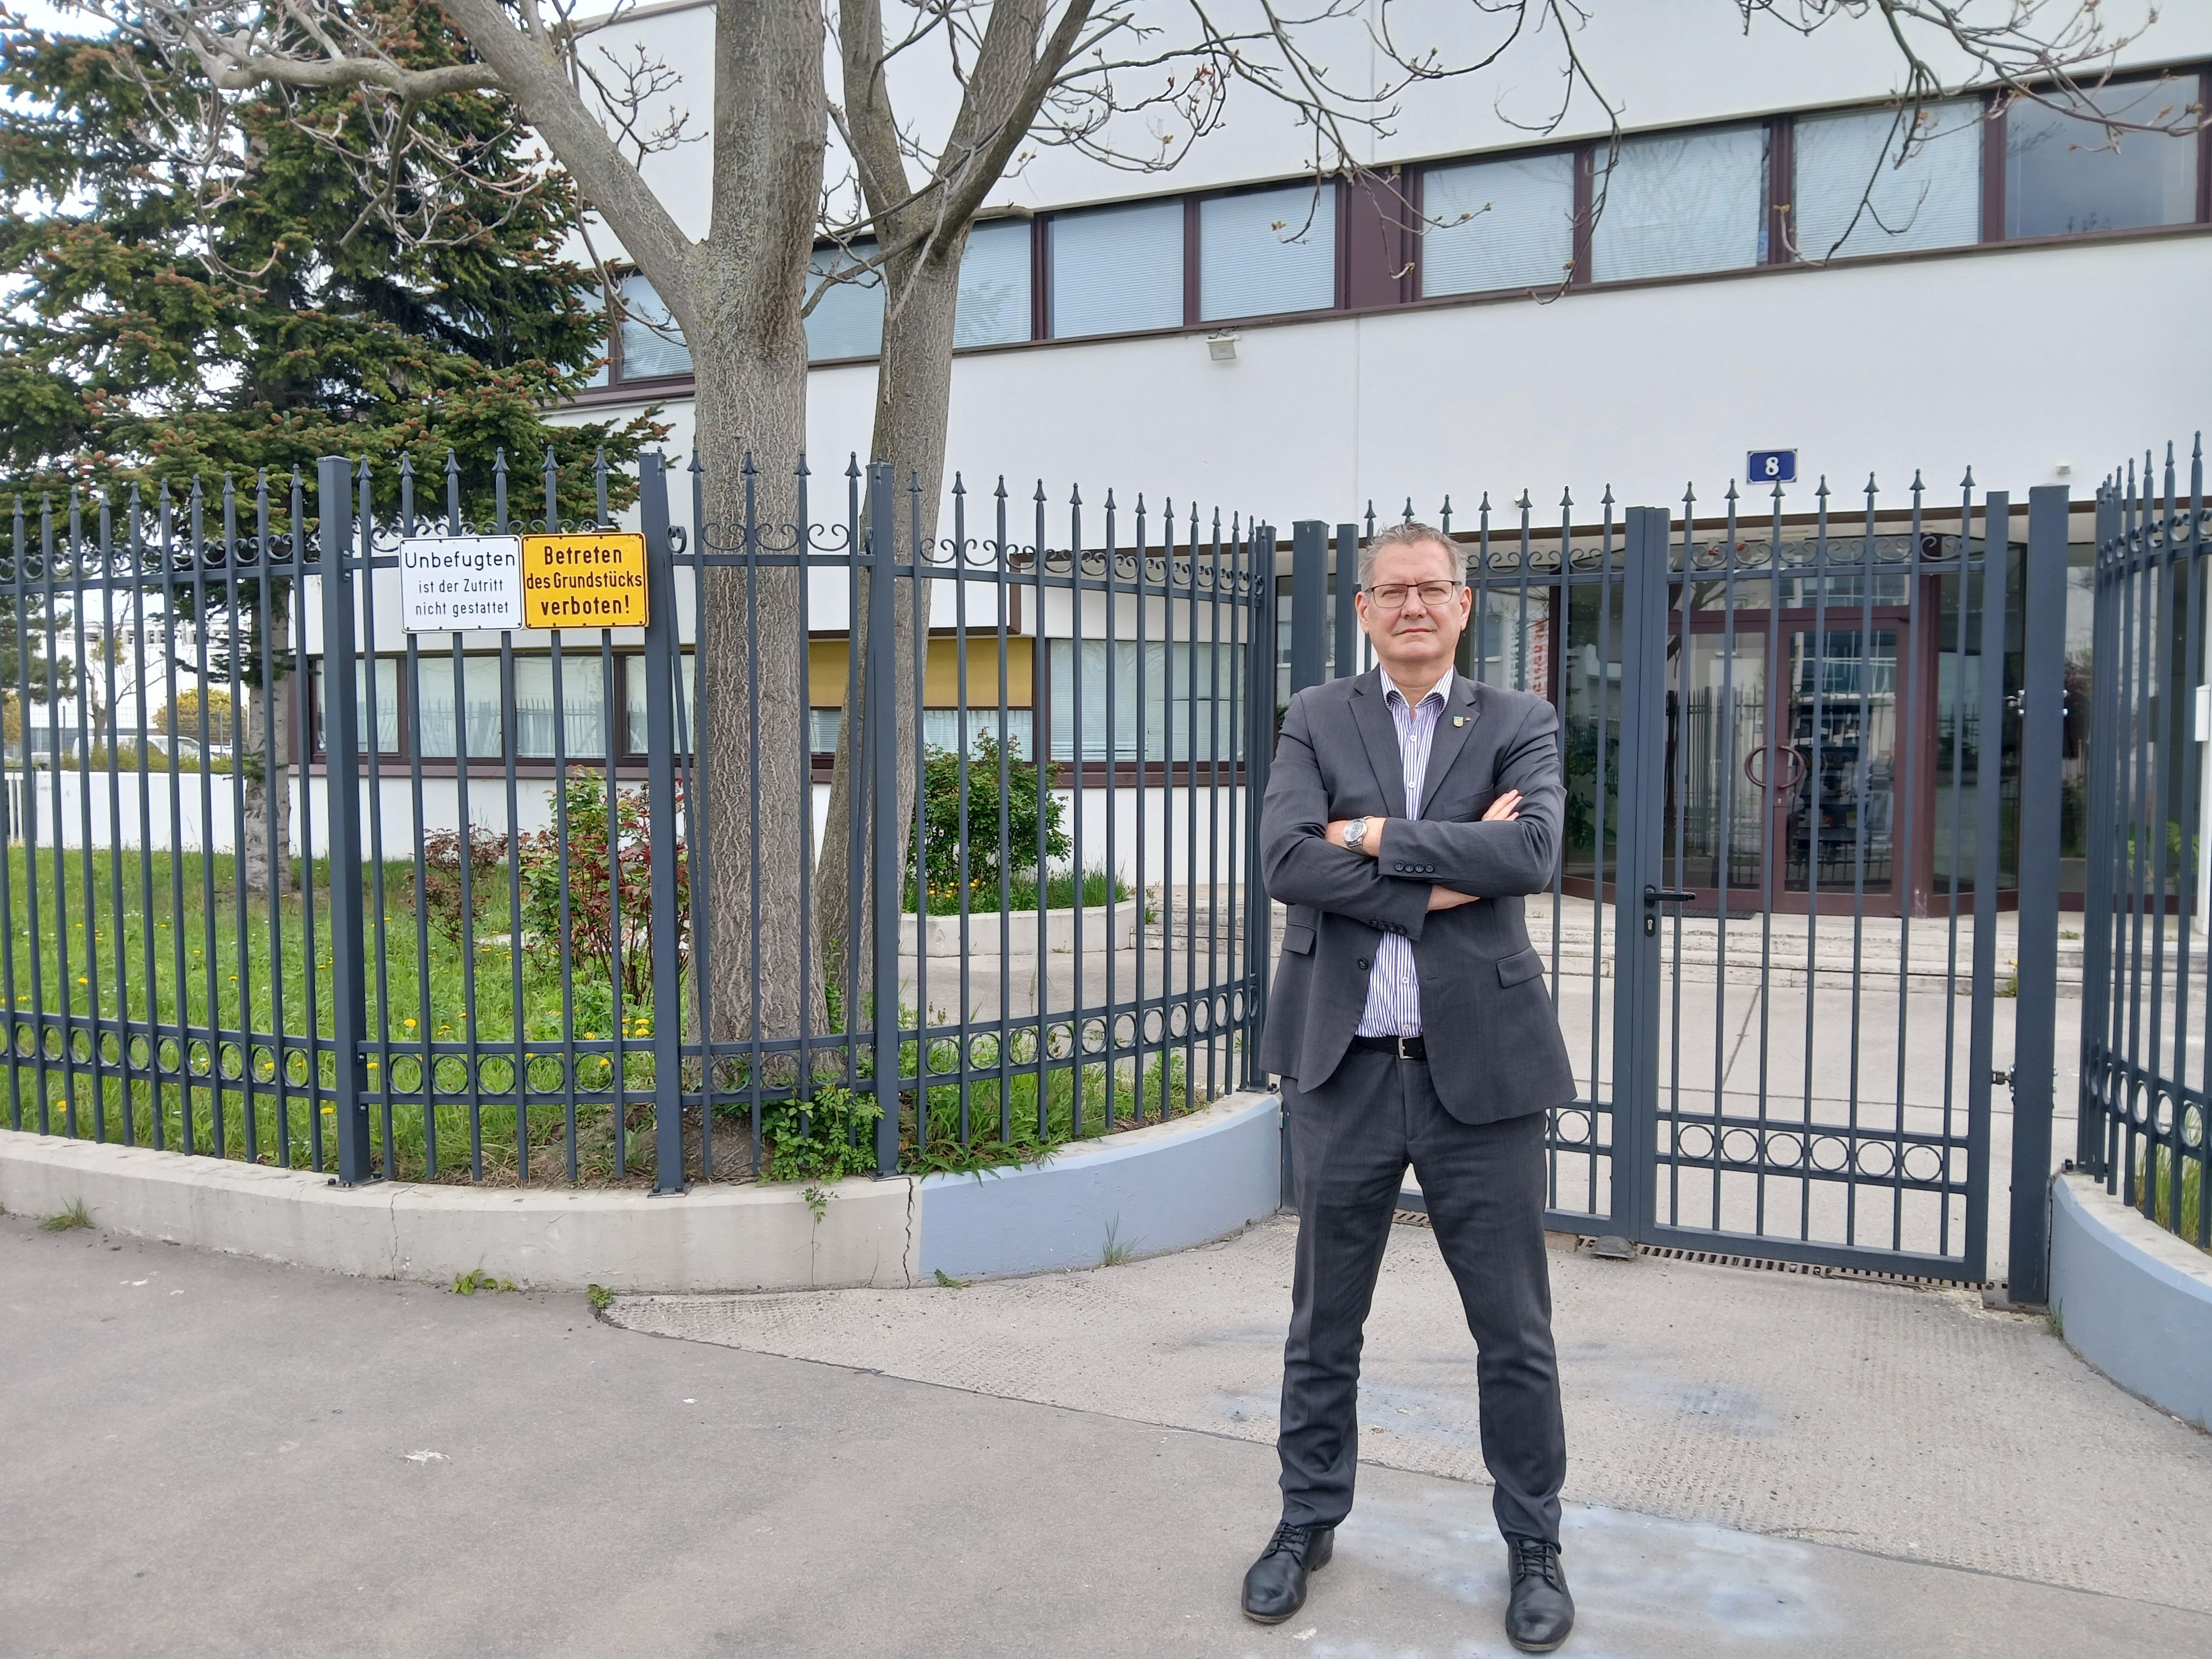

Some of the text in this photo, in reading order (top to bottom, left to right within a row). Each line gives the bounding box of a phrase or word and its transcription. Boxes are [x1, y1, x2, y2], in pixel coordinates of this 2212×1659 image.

[1765, 456, 1779, 476] 8
[405, 551, 515, 571] Unbefugten
[544, 546, 622, 565] Betreten
[419, 578, 503, 593] ist der Zutritt
[526, 570, 643, 589] des Grundstücks
[415, 601, 509, 618] nicht gestattet
[541, 594, 630, 616] verboten!
